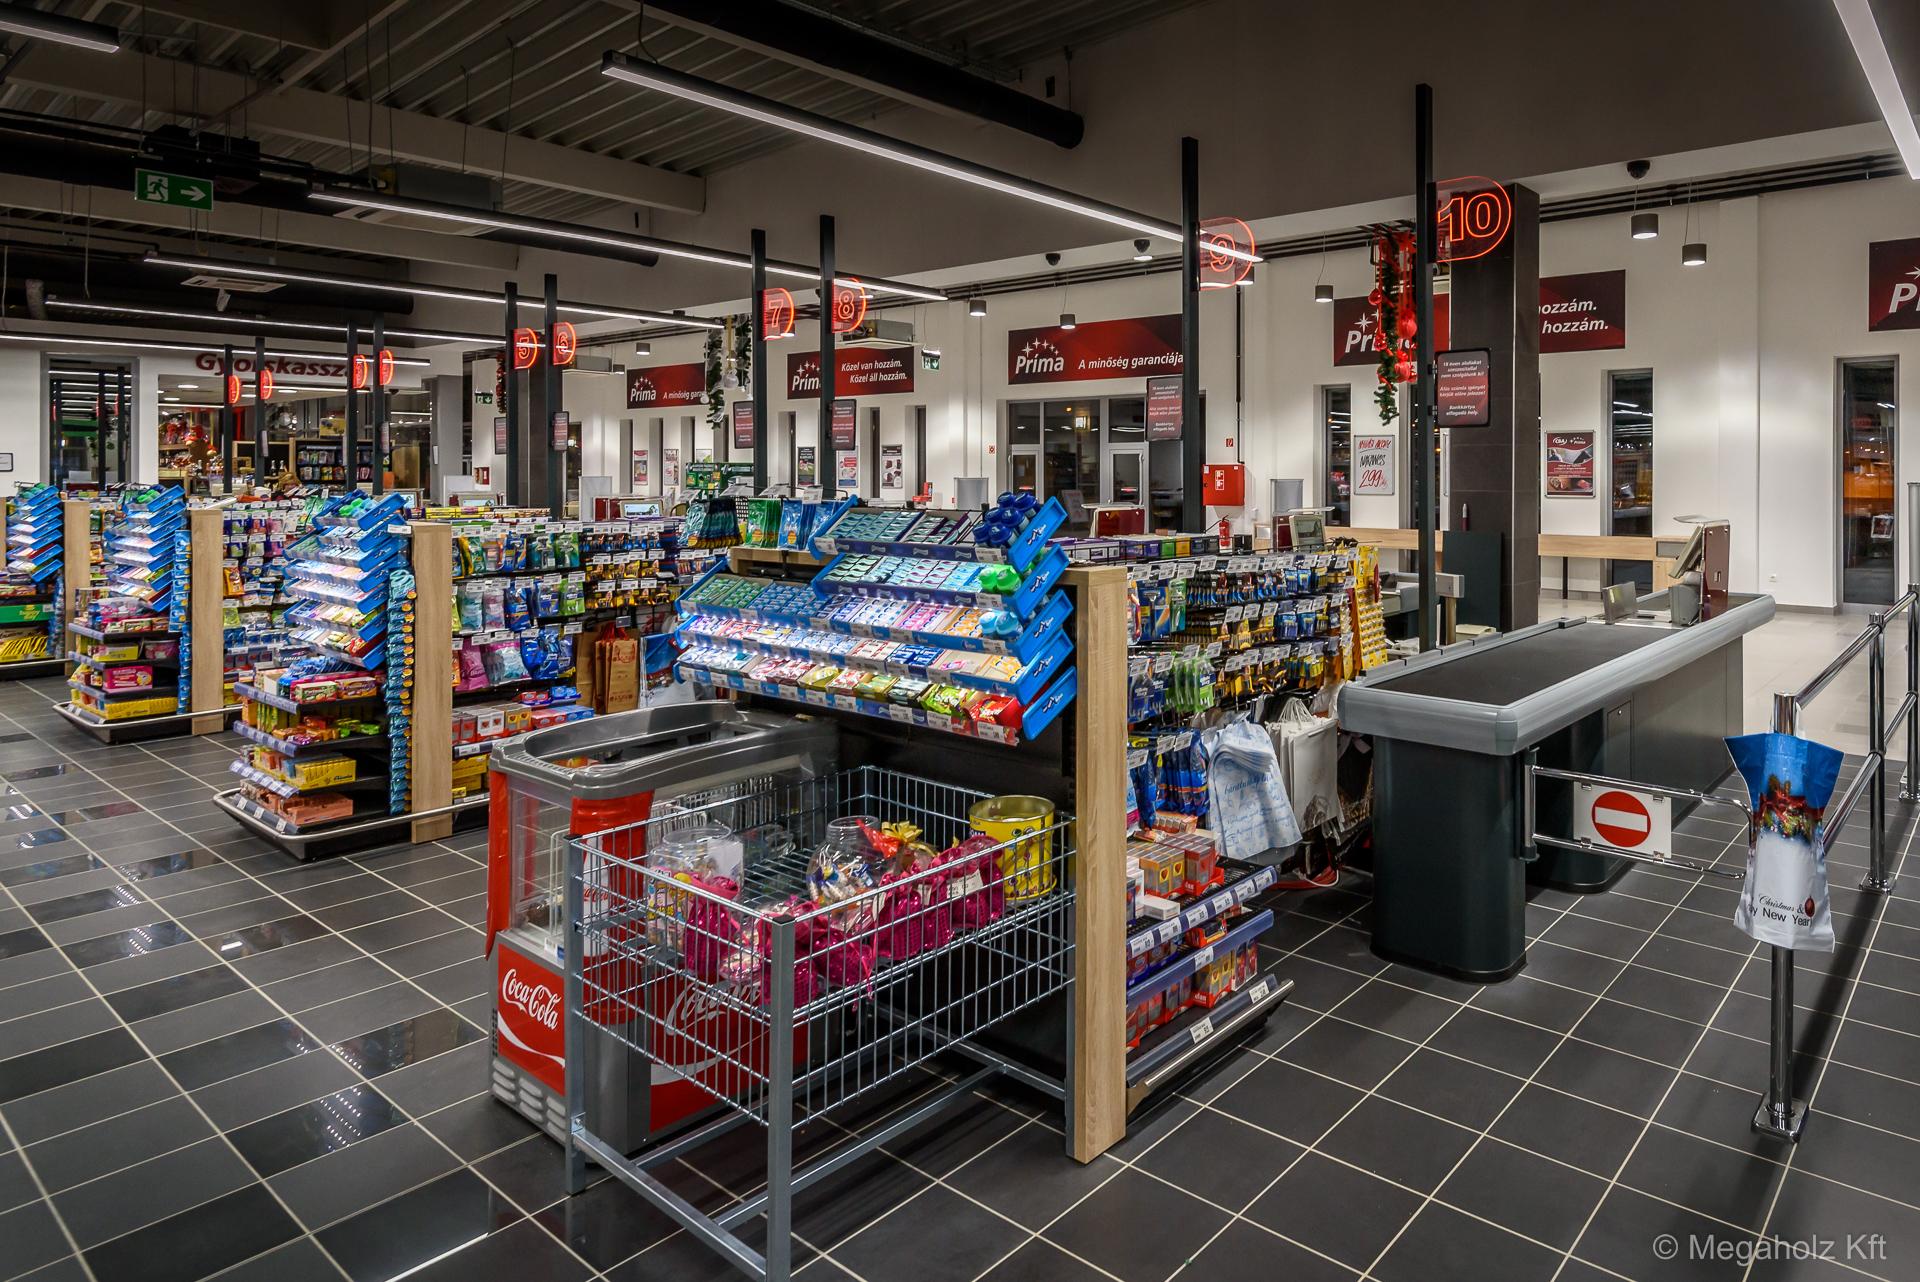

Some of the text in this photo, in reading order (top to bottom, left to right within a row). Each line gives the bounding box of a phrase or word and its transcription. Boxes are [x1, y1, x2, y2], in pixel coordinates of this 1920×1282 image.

[1437, 193, 1501, 242] 10
[1209, 234, 1235, 272] 9
[769, 300, 784, 328] 7
[838, 290, 855, 320] 8
[1539, 298, 1597, 314] ozzám.
[1542, 317, 1609, 334] hozzám.
[518, 337, 530, 359] 5
[557, 332, 569, 354] 6
[196, 353, 347, 377] Gyoskassz
[841, 359, 903, 372] Közel van hozzám.
[1078, 352, 1183, 370] A minőség garanciája
[792, 373, 821, 391] Prím
[850, 371, 907, 383] Közel áll hozzám.
[663, 391, 668, 399] A
[1759, 895, 1795, 911] Christmas
[1763, 907, 1787, 922] New
[502, 968, 562, 1030] Coca-Cola
